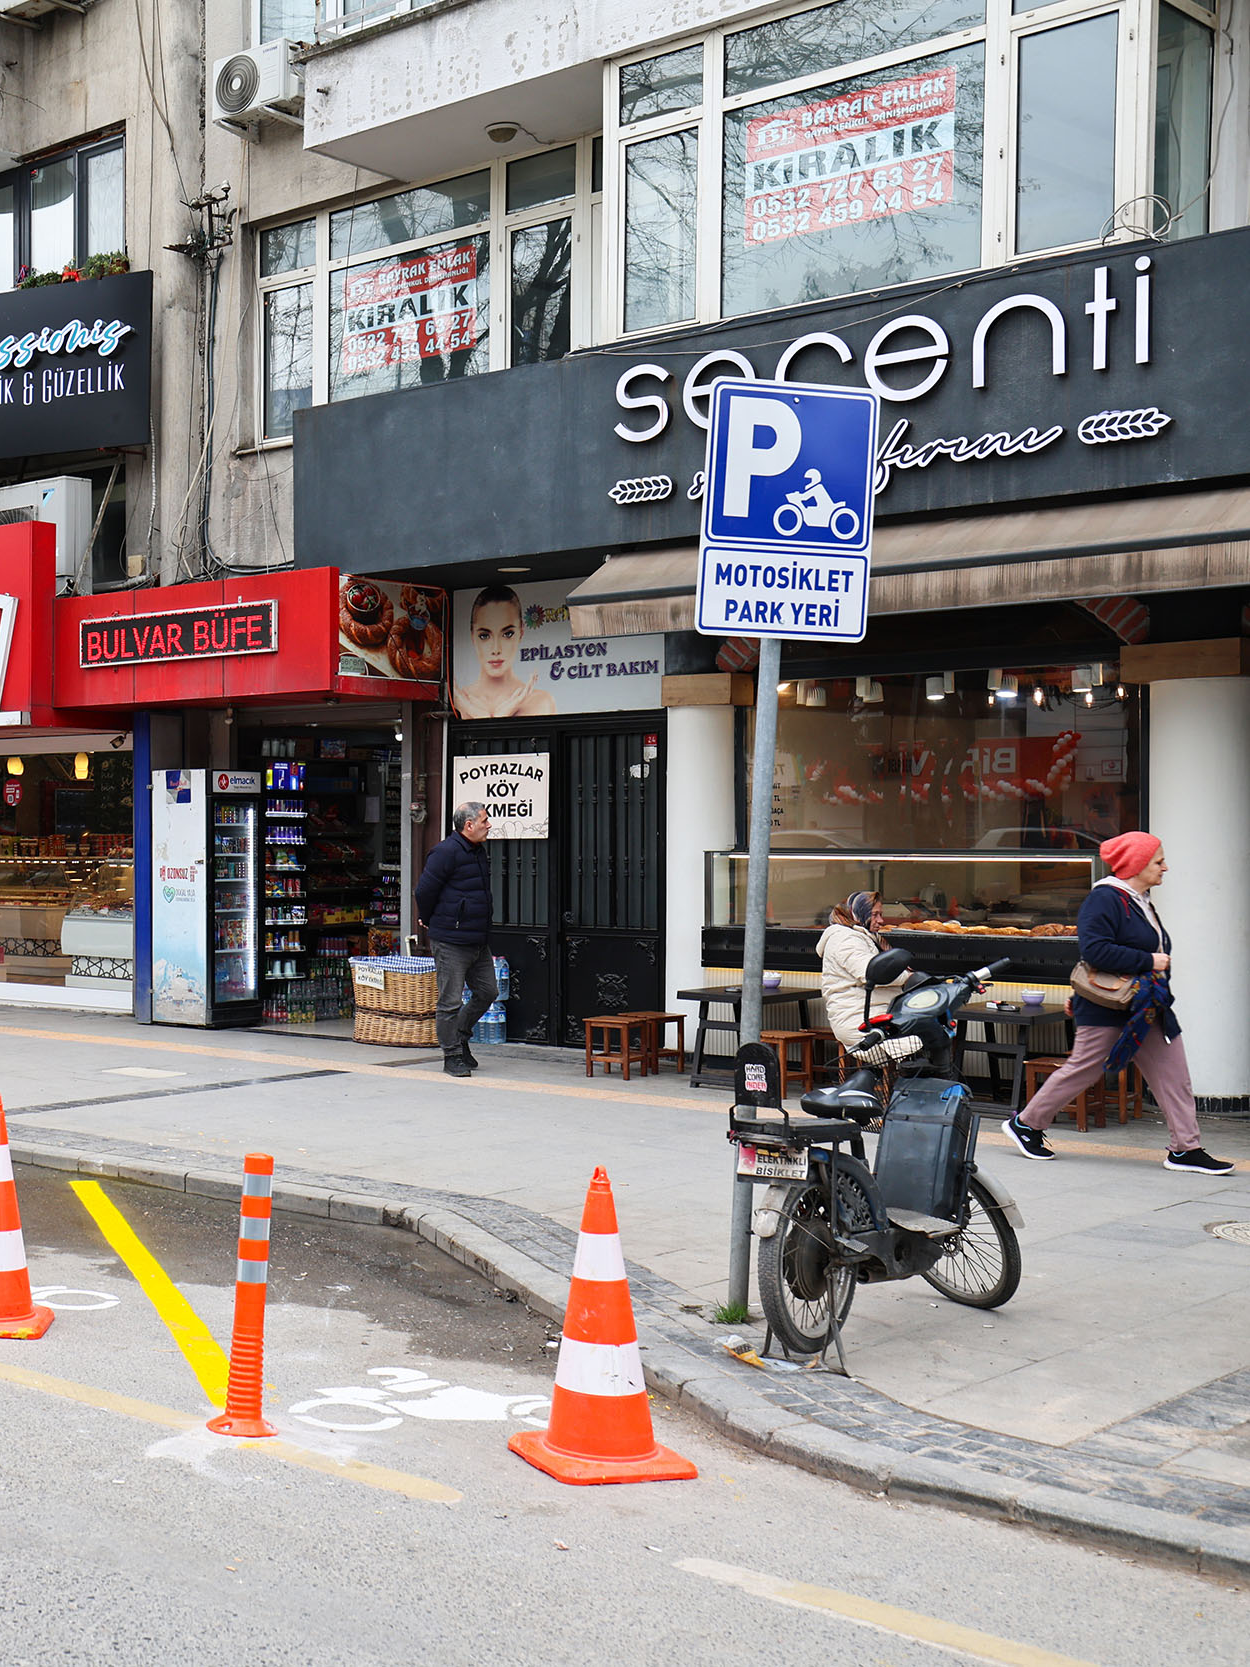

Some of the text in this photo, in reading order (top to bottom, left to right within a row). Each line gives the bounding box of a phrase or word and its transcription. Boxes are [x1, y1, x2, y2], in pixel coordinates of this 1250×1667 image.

[801, 75, 947, 128] BAYRAK EMLAK
[753, 156, 944, 218] 0532 727 63 27
[752, 181, 944, 240] 0532 459 44 54
[378, 251, 470, 285] BAYRAK EMLAK
[350, 331, 386, 353] 0532
[425, 318, 446, 336] 63
[450, 311, 471, 330] 27
[347, 331, 471, 370] 0532 459 44 54
[23, 371, 34, 406] &
[42, 360, 125, 404] GÜZELLİK
[723, 395, 802, 518] P
[715, 561, 854, 593] MOTOSİKLET
[725, 598, 840, 627] PARK YERİ
[86, 612, 263, 661] BULVAR BÜFE
[520, 642, 608, 661] EPİLASYON
[550, 660, 659, 681] & CİLT BAKIM
[459, 762, 544, 785] POYRAZLAR
[486, 780, 520, 798] KÖY
[483, 799, 533, 818] KMEĞİ
[756, 1166, 806, 1179] BİSİKLET
